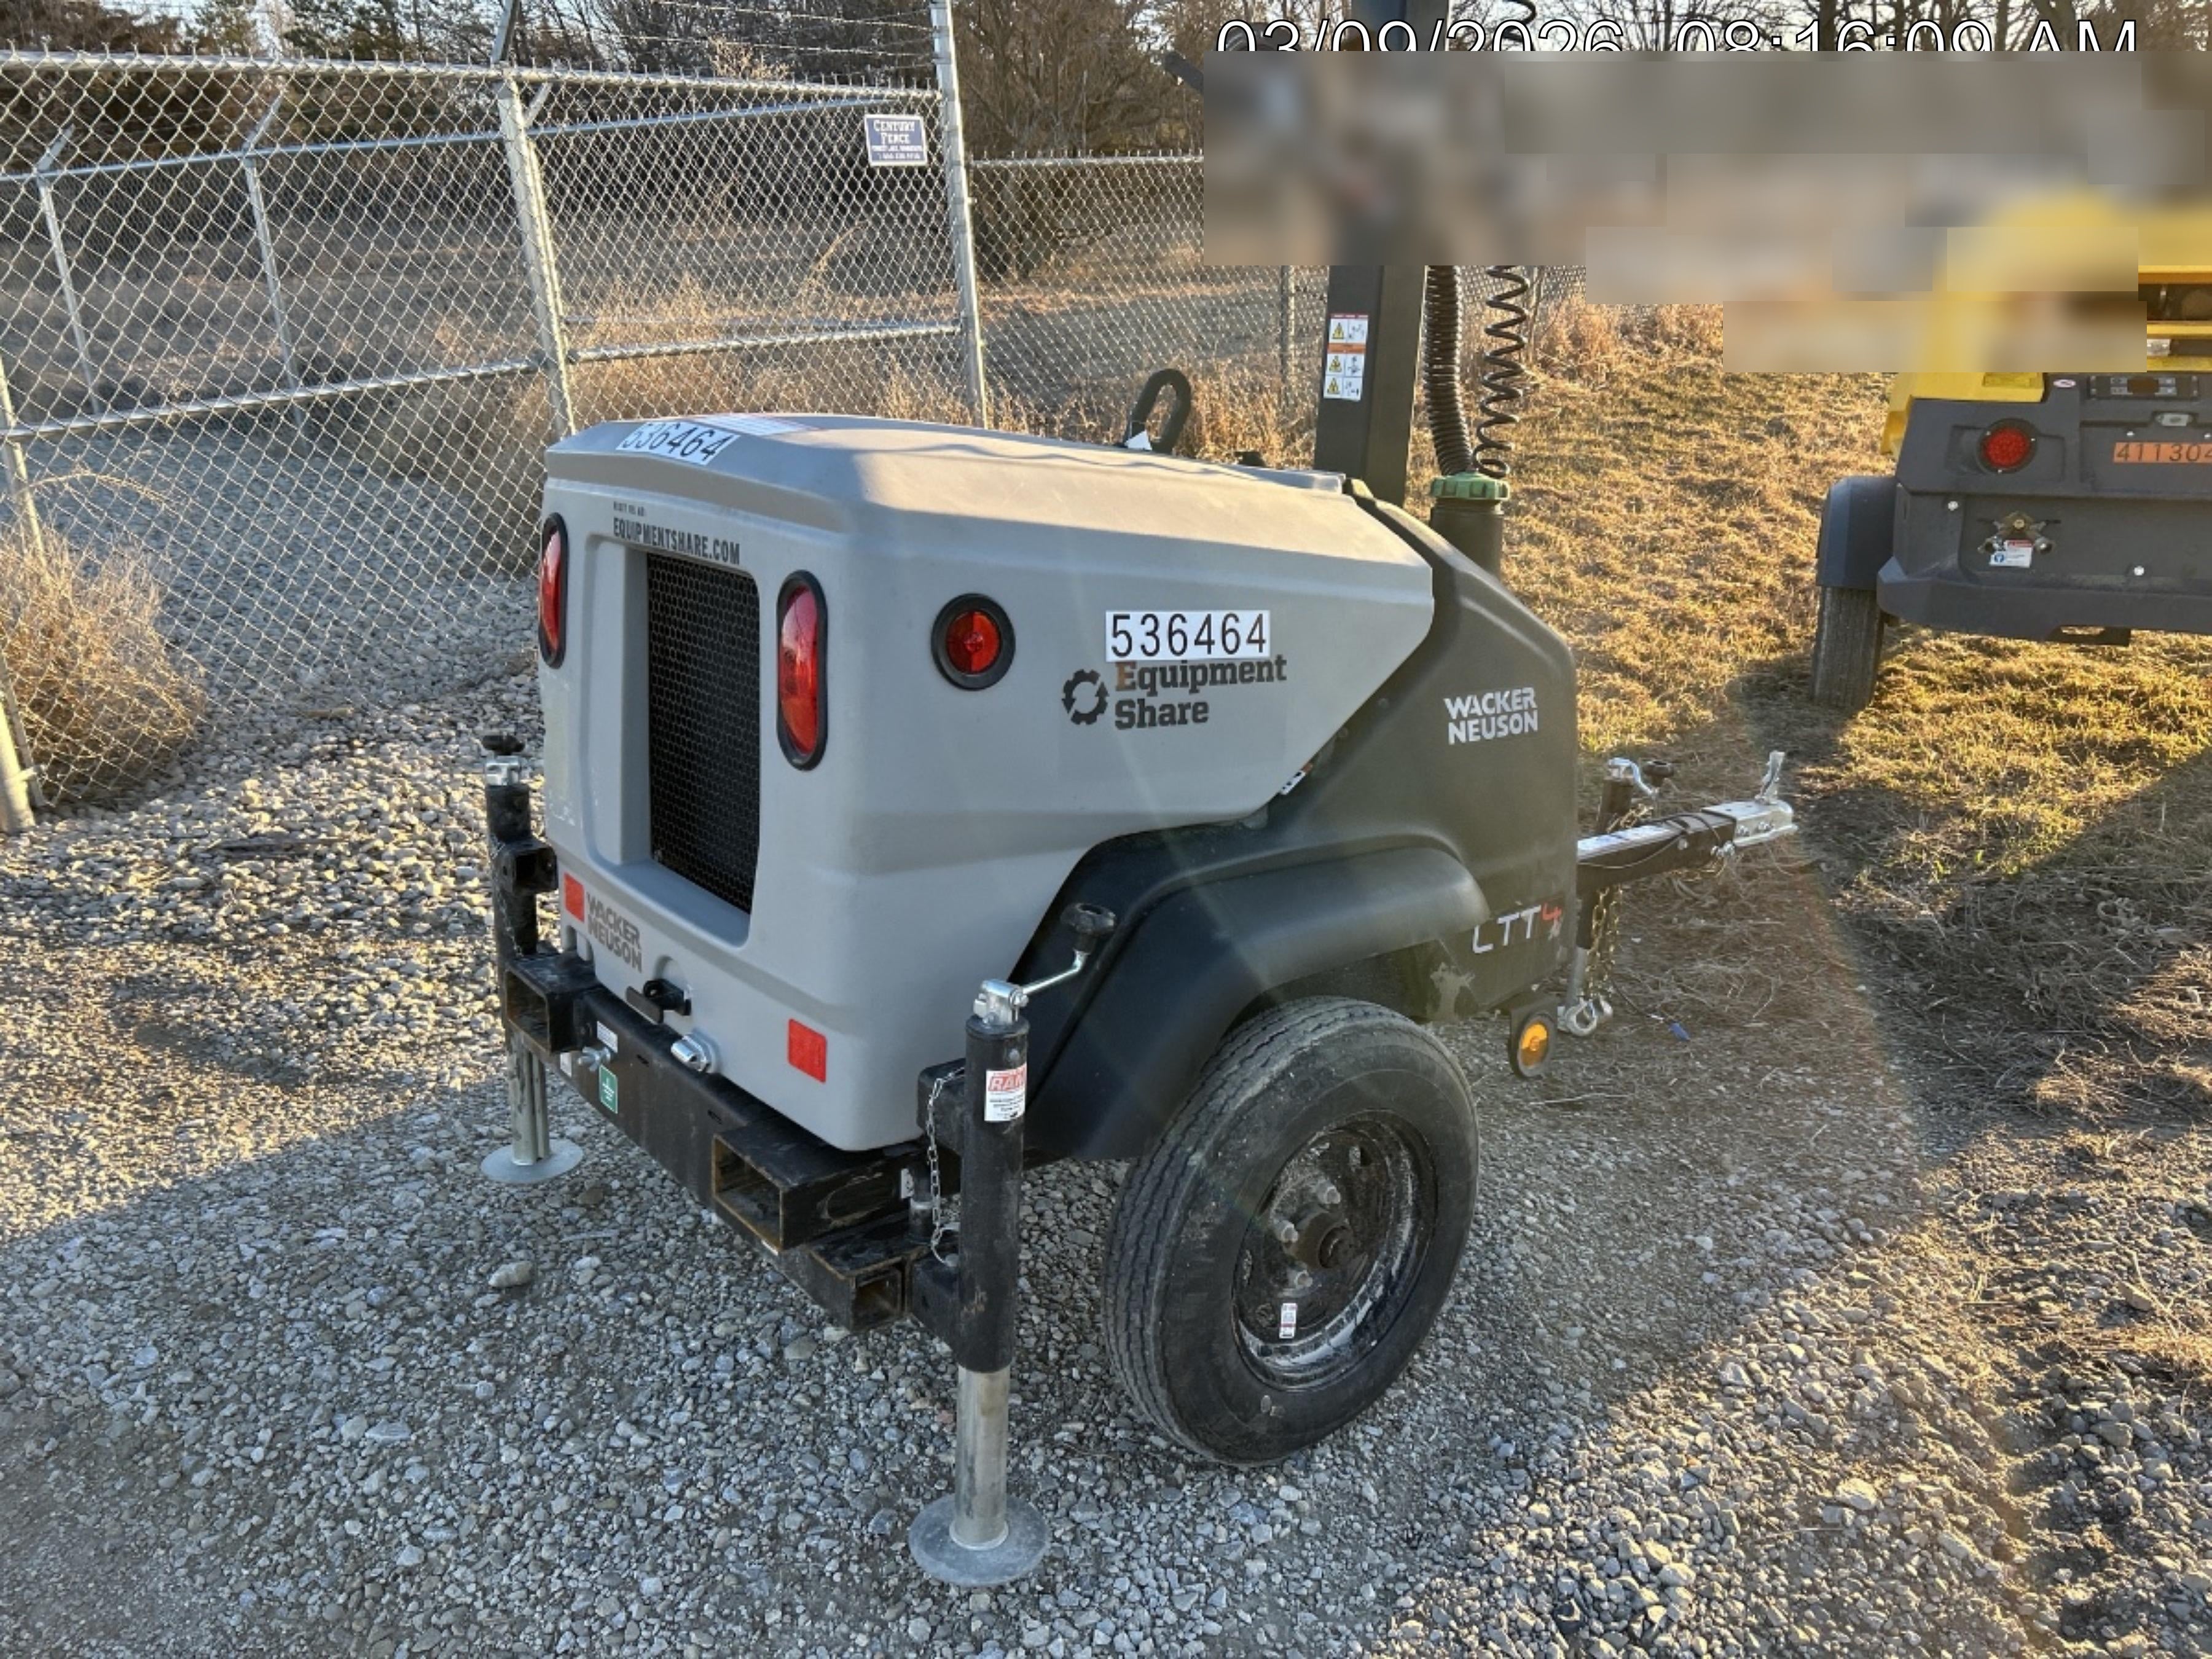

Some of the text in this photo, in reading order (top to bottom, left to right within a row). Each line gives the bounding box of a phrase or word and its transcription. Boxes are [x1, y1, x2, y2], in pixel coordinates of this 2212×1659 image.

[873, 119, 915, 131] CENTURY
[880, 132, 911, 144] FENCE
[622, 422, 736, 461] 536464
[613, 517, 740, 565] EQUIPMENTSHARE.COM
[1111, 613, 1266, 657] 536464
[1115, 654, 1287, 697] Equipment
[1114, 698, 1210, 730] Share
[1443, 686, 1538, 720] WACKER
[1448, 709, 1539, 745] NEUSON
[586, 891, 641, 950] WACKER
[587, 914, 643, 973] NEUSON
